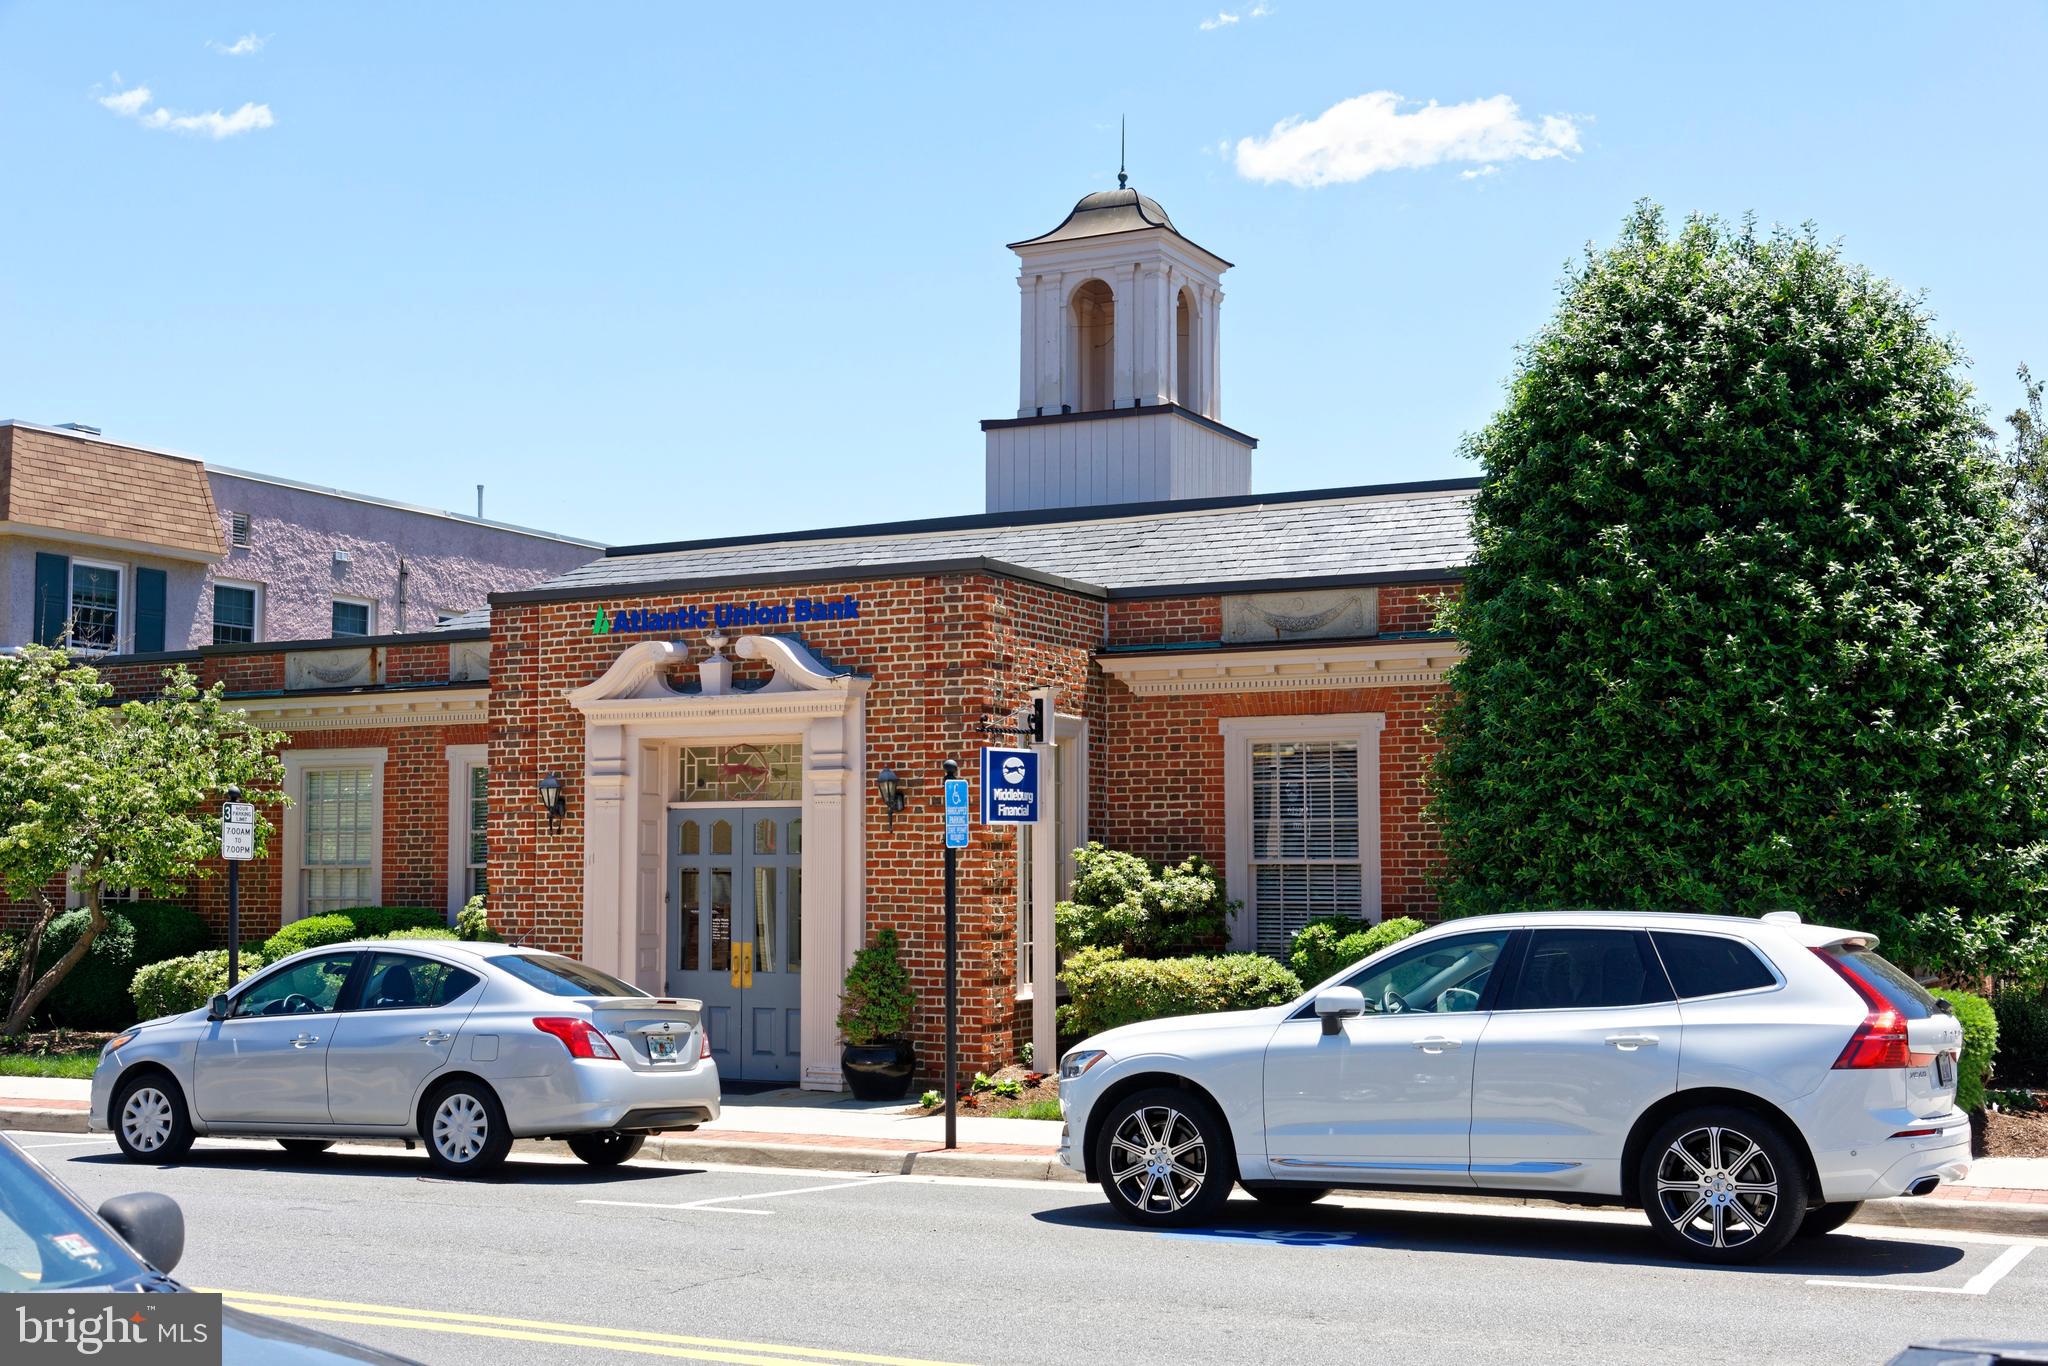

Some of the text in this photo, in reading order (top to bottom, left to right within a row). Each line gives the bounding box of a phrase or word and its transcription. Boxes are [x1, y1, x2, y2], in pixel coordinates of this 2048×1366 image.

[612, 595, 860, 633] Atlantic Union Bank
[993, 788, 1034, 804] Middleburg
[224, 806, 231, 820] 3
[997, 804, 1030, 817] Financial
